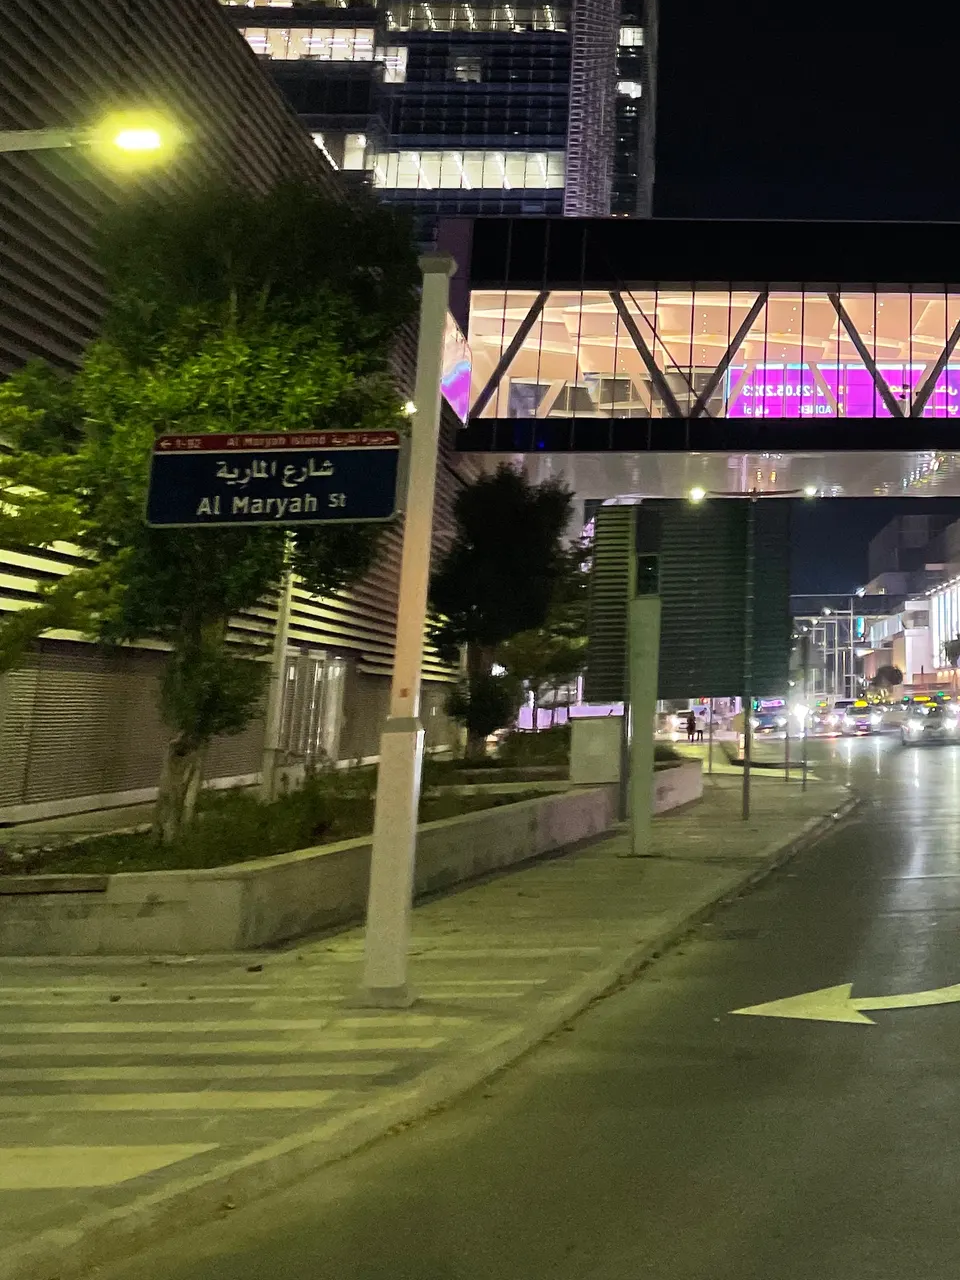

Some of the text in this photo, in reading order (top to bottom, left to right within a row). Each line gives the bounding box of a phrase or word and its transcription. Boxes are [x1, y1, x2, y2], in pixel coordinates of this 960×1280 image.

[226, 436, 239, 447] Al
[243, 436, 287, 448] Maryah
[282, 457, 334, 488] شارع
[195, 492, 348, 519] Al Maryah St
